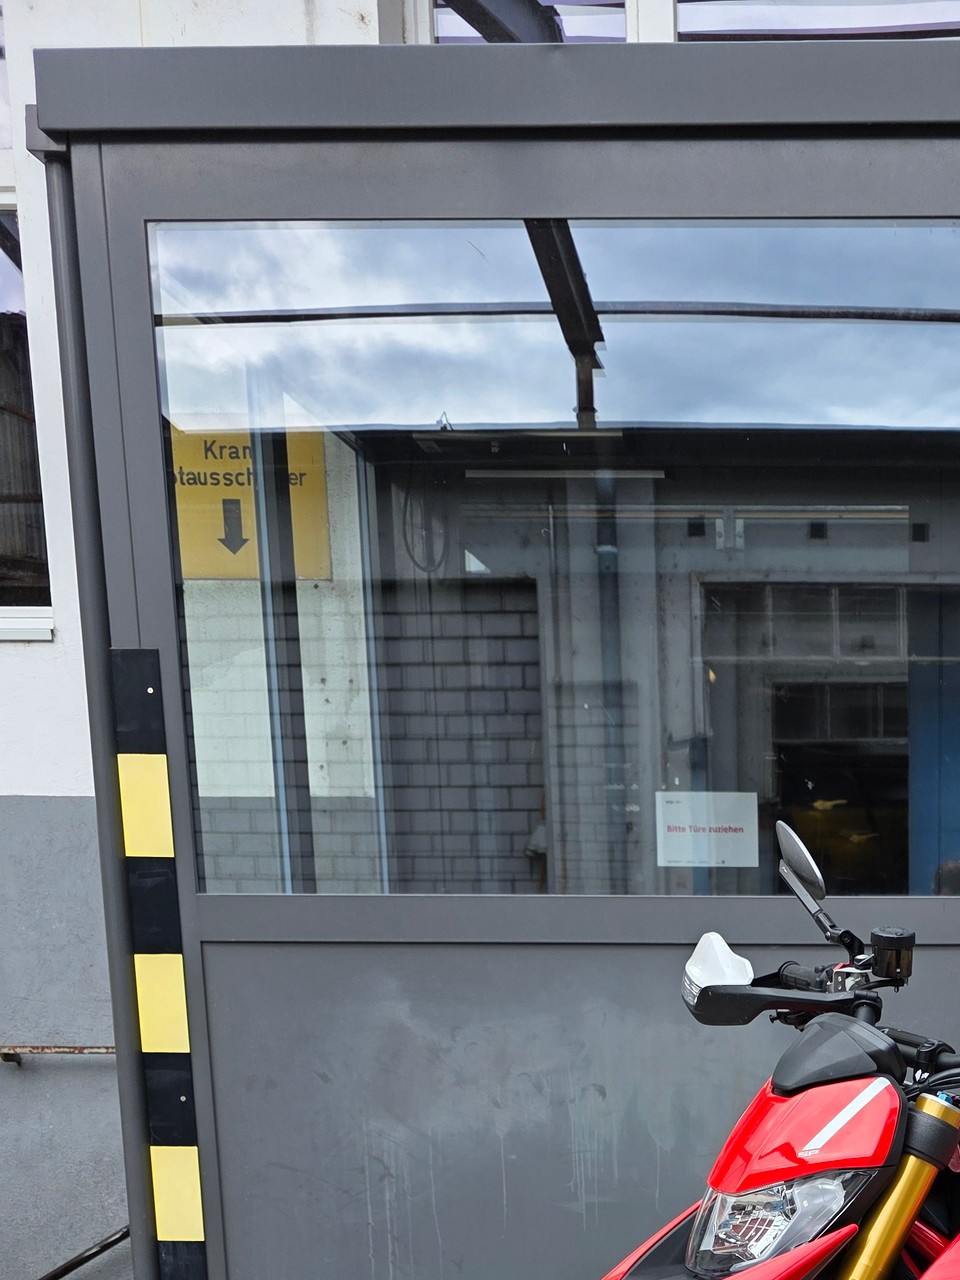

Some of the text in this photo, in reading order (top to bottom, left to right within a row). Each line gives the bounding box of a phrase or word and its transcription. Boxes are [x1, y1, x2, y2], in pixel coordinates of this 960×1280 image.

[203, 439, 252, 461] Kran
[667, 825, 744, 834] Bitte Türe zuziehen
[797, 1149, 820, 1158] SP
